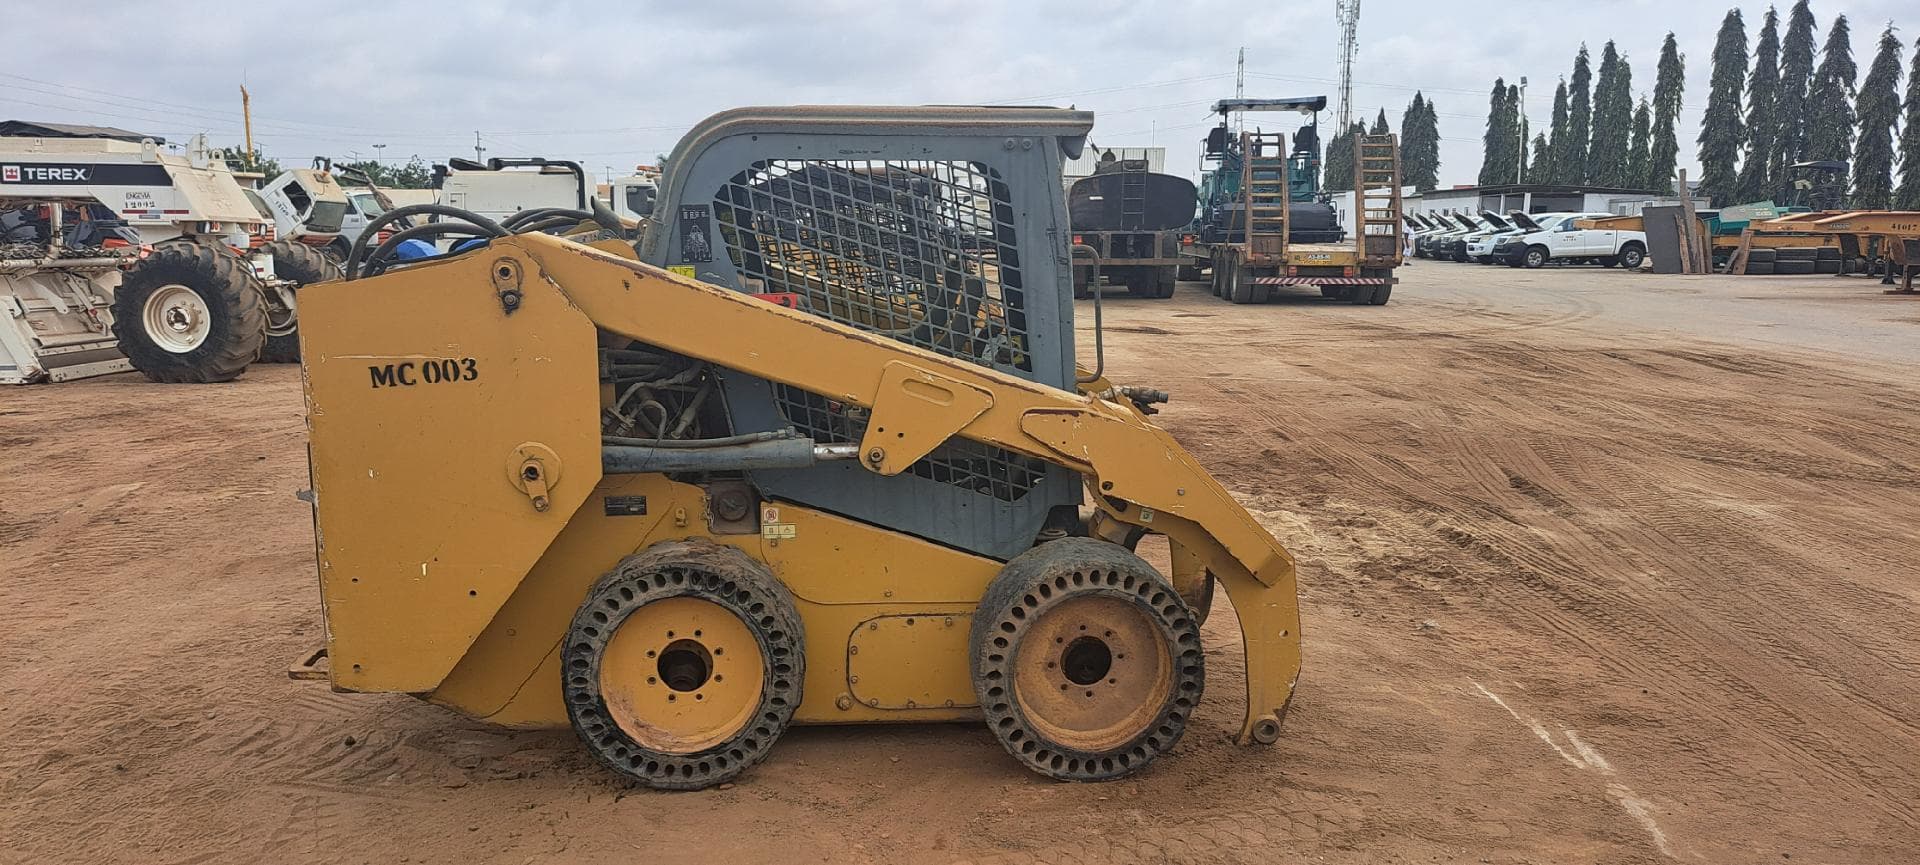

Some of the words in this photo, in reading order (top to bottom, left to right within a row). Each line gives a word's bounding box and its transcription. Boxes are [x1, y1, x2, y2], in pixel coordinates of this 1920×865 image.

[23, 167, 87, 181] TEREX
[368, 362, 417, 389] MC
[422, 357, 478, 384] 003
